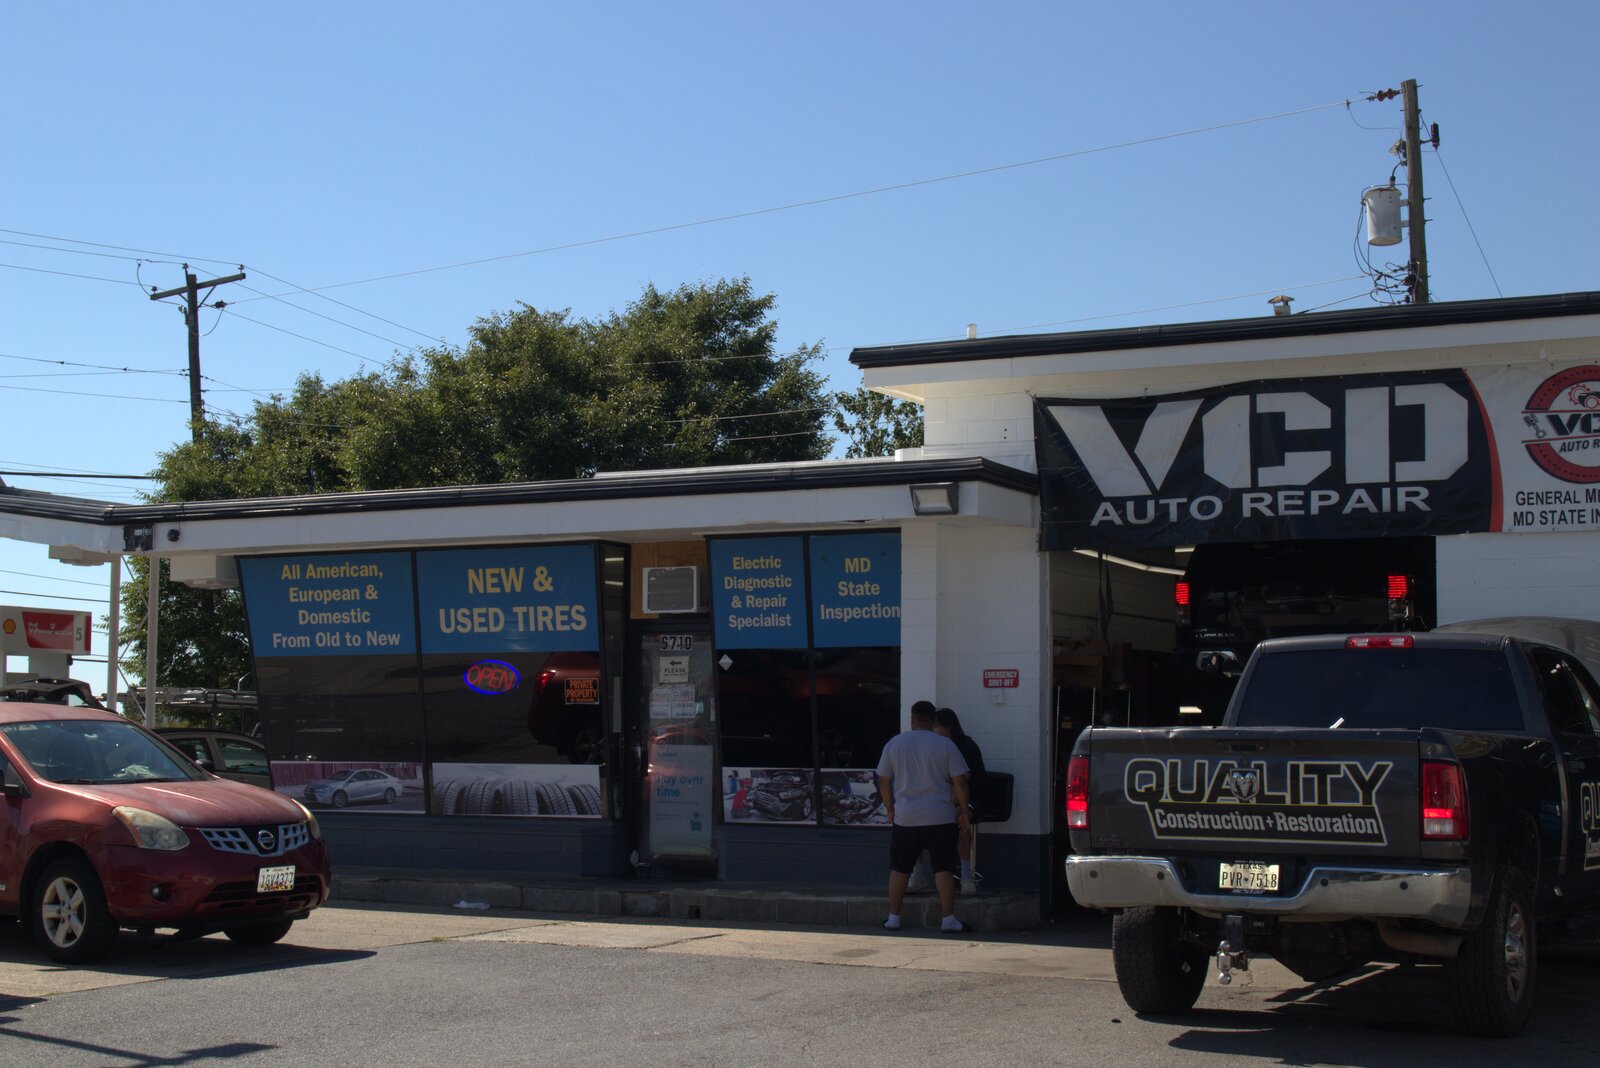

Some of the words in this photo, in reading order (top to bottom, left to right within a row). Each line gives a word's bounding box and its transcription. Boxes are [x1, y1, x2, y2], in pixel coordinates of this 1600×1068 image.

[1047, 383, 1469, 497] VCD
[1560, 440, 1590, 453] AUTO
[1090, 496, 1224, 527] AUTO
[1242, 486, 1432, 518] REPAIR
[1515, 491, 1581, 506] GENERAL
[1513, 511, 1535, 526] MD
[1540, 509, 1586, 525] STATE
[281, 565, 300, 580] All
[306, 562, 383, 580] American,
[732, 555, 781, 570] Electric
[844, 558, 872, 573] MD
[467, 567, 525, 594] NEW
[533, 566, 554, 592] &
[724, 575, 793, 591] Diagnostic
[838, 581, 881, 596] State
[289, 586, 360, 605] European
[365, 584, 378, 600] &
[731, 595, 742, 609] &
[746, 594, 787, 610] Repair
[298, 608, 371, 625] Domestic
[439, 607, 505, 634] USED
[512, 604, 588, 632] TIRES
[728, 613, 792, 630] Specialist
[820, 603, 901, 623] Inspection
[76, 627, 82, 641] 5
[272, 632, 310, 648] From
[315, 632, 340, 648] Old
[345, 632, 361, 647] to
[366, 631, 401, 646] New
[467, 665, 515, 690] OPEN
[985, 671, 1017, 679] EMERGENCY
[570, 680, 593, 688] PRIVATE
[566, 688, 597, 698] PROPERTY
[1124, 758, 1394, 805] QUALITY
[657, 786, 681, 797] time
